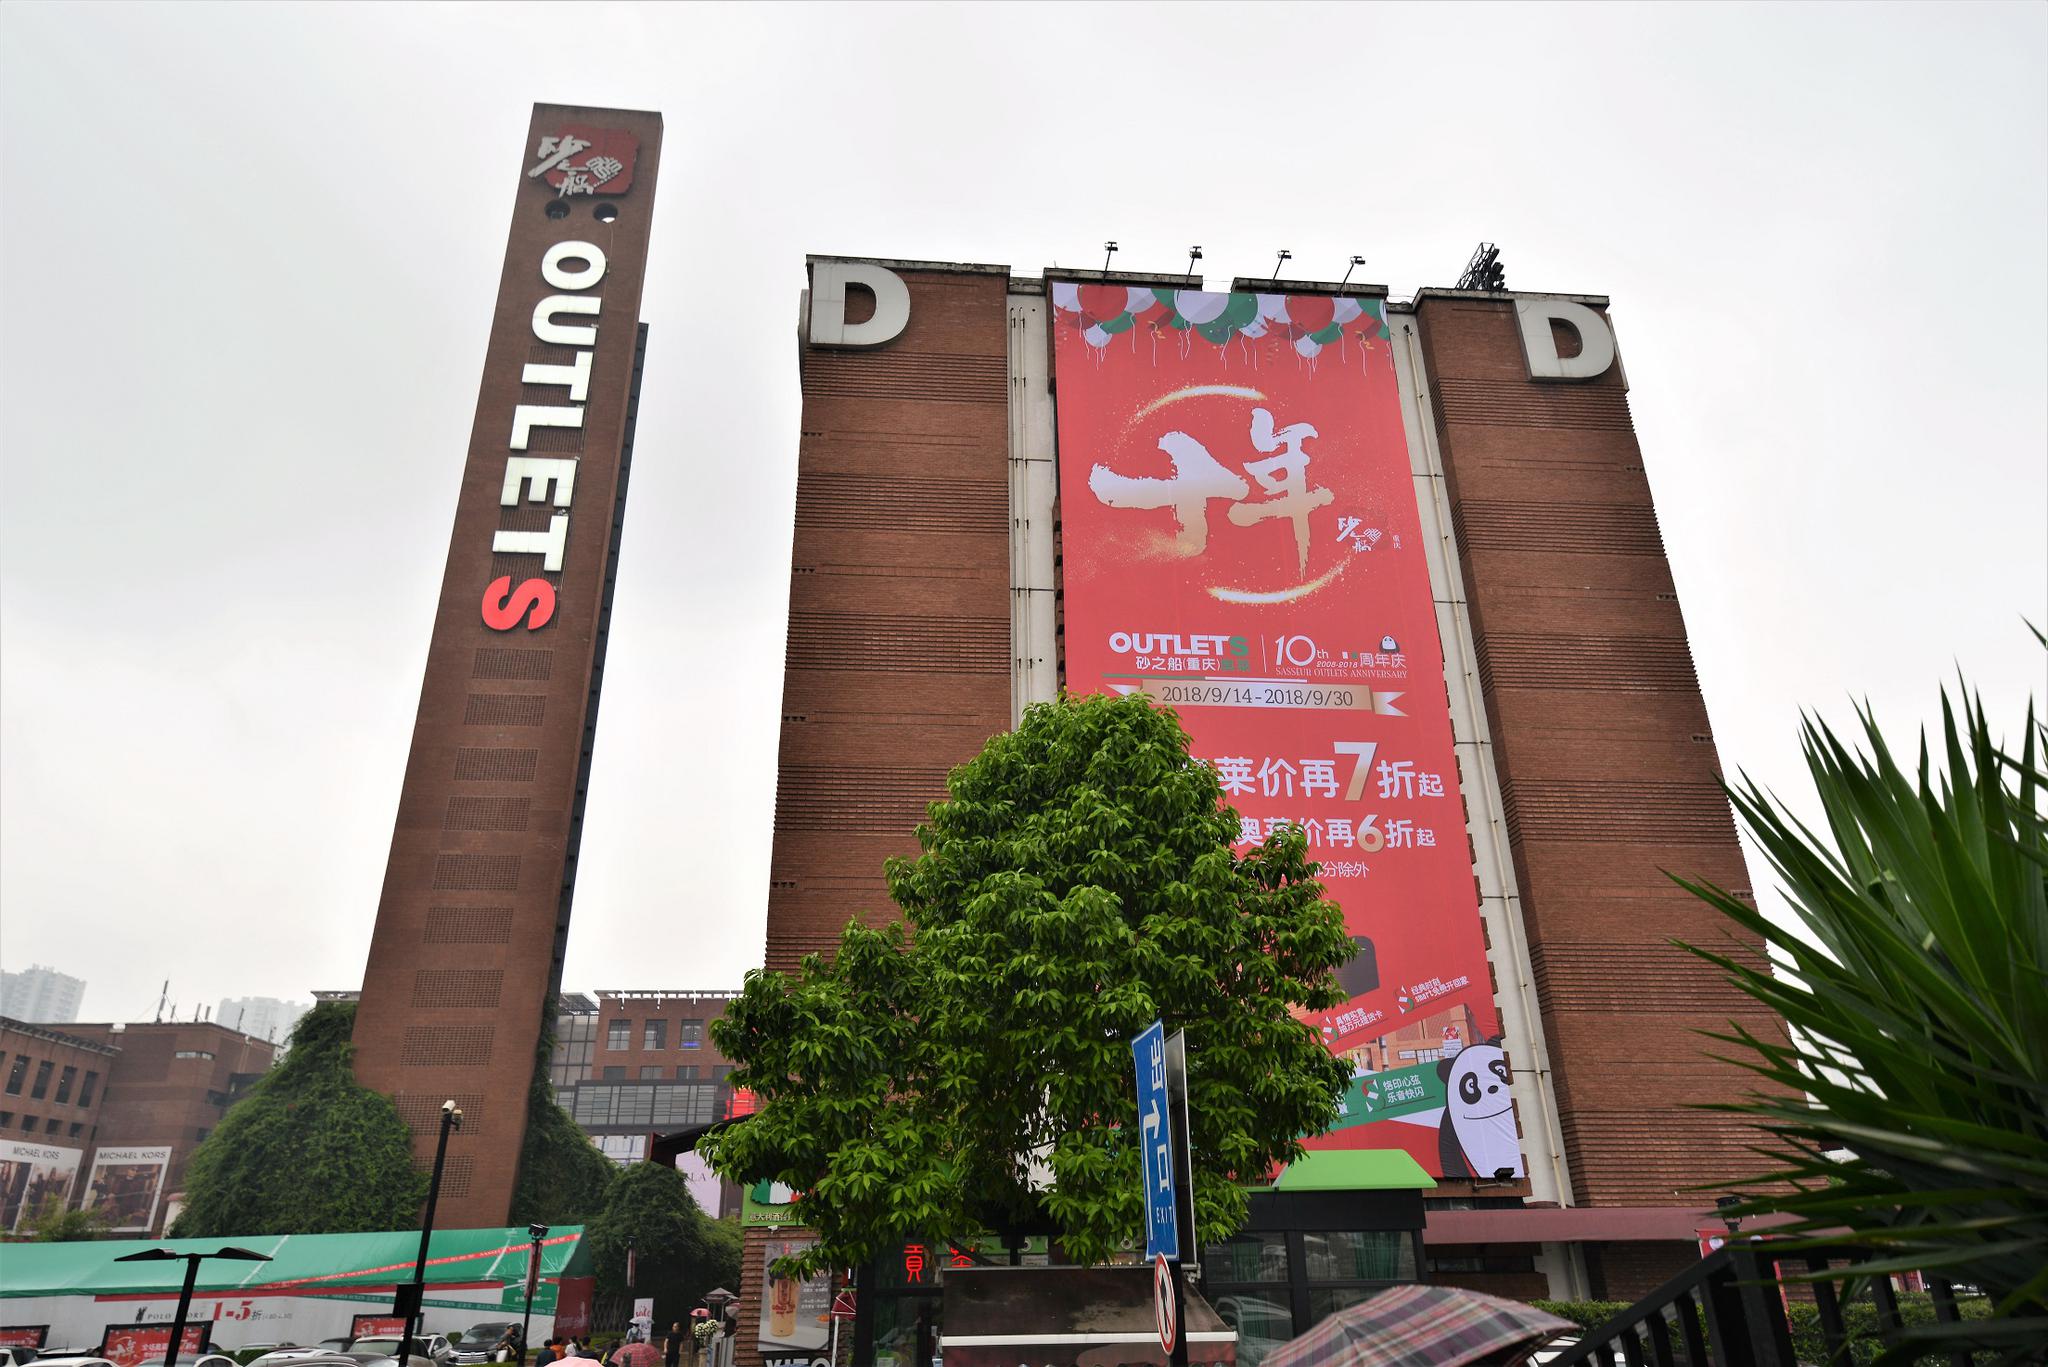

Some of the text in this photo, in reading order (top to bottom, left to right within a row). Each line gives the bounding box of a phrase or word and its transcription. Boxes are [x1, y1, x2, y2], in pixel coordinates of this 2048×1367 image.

[809, 261, 911, 349] D
[1514, 298, 1617, 382] D
[481, 239, 607, 632] OUTLETS
[1088, 407, 1335, 582] 十年
[1109, 632, 1249, 656] OUTLETS
[1316, 660, 1359, 668] 2008-2018
[1360, 652, 1407, 669] 周年庆
[1276, 667, 1408, 679] SASSEUR OUTLETS ANNIVERSARY
[1189, 741, 1445, 801] 莱价再7折起
[1383, 1074, 1422, 1092] 烙印心弦
[12, 1146, 61, 1160] MICHAEL KORS
[98, 1151, 167, 1160] MICHAEL KORS
[1156, 1206, 1173, 1224] EXIT
